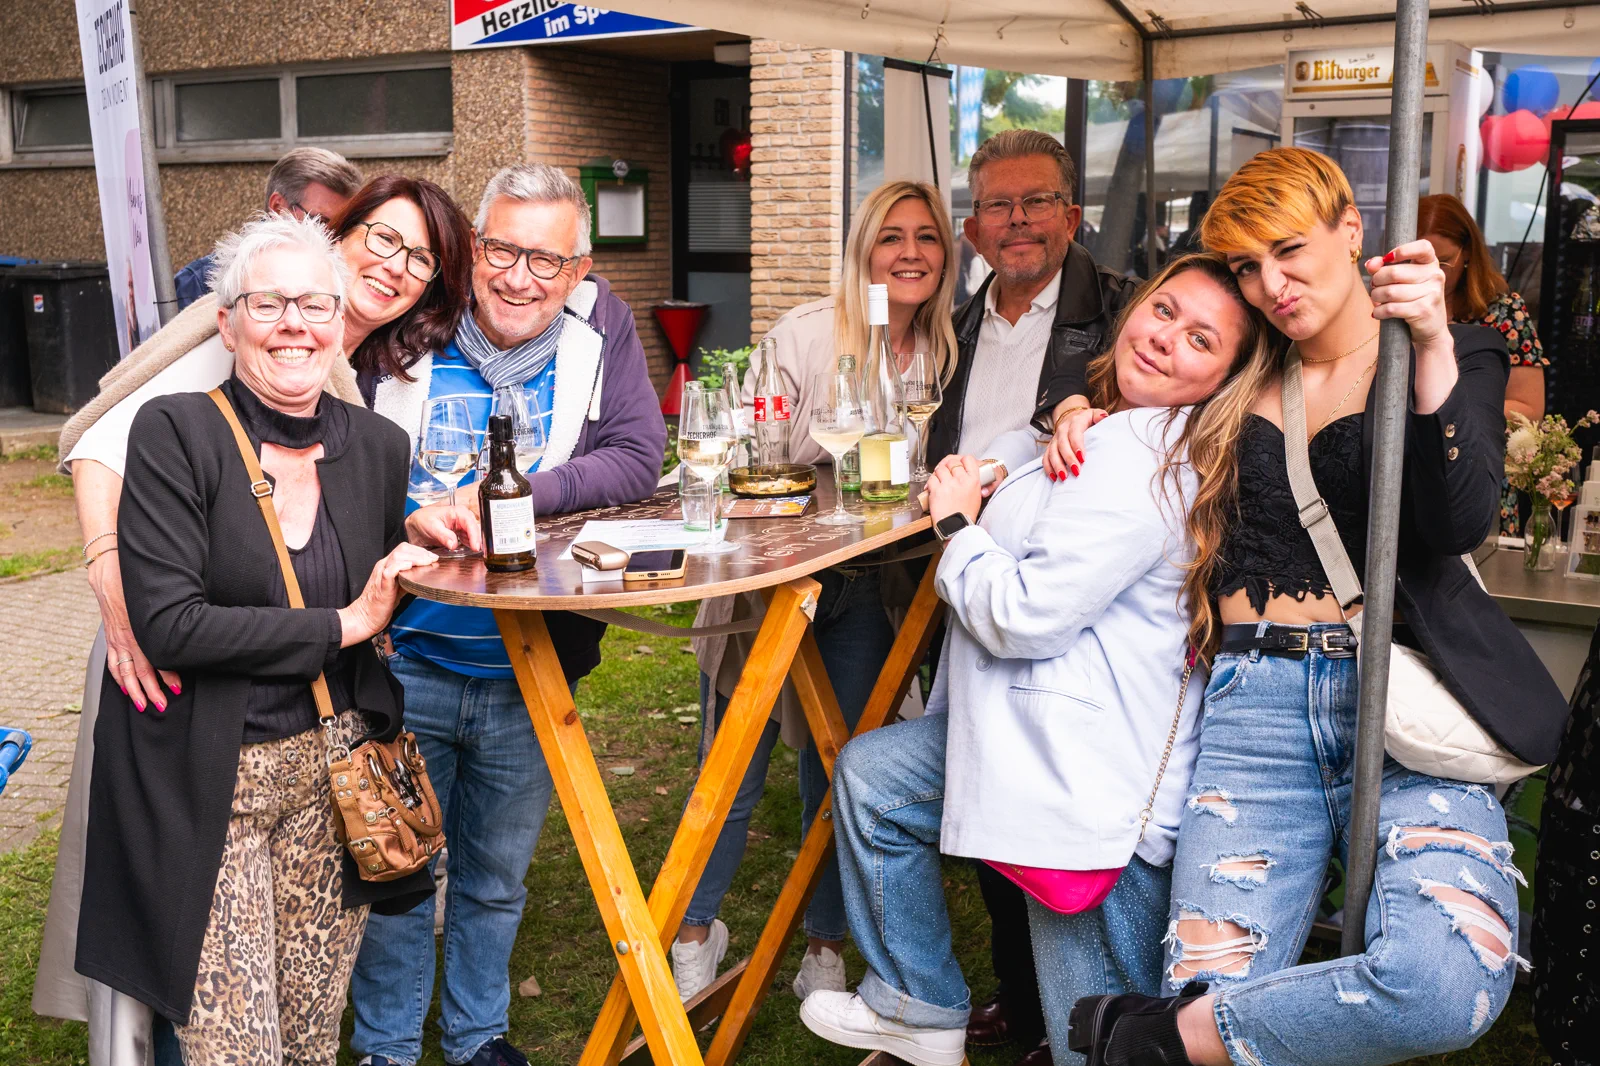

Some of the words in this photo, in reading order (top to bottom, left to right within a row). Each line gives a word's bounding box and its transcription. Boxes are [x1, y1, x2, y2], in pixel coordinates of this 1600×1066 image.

[543, 15, 571, 37] im
[1313, 60, 1381, 82] Bitburger
[686, 431, 717, 440] ZECHERHOF
